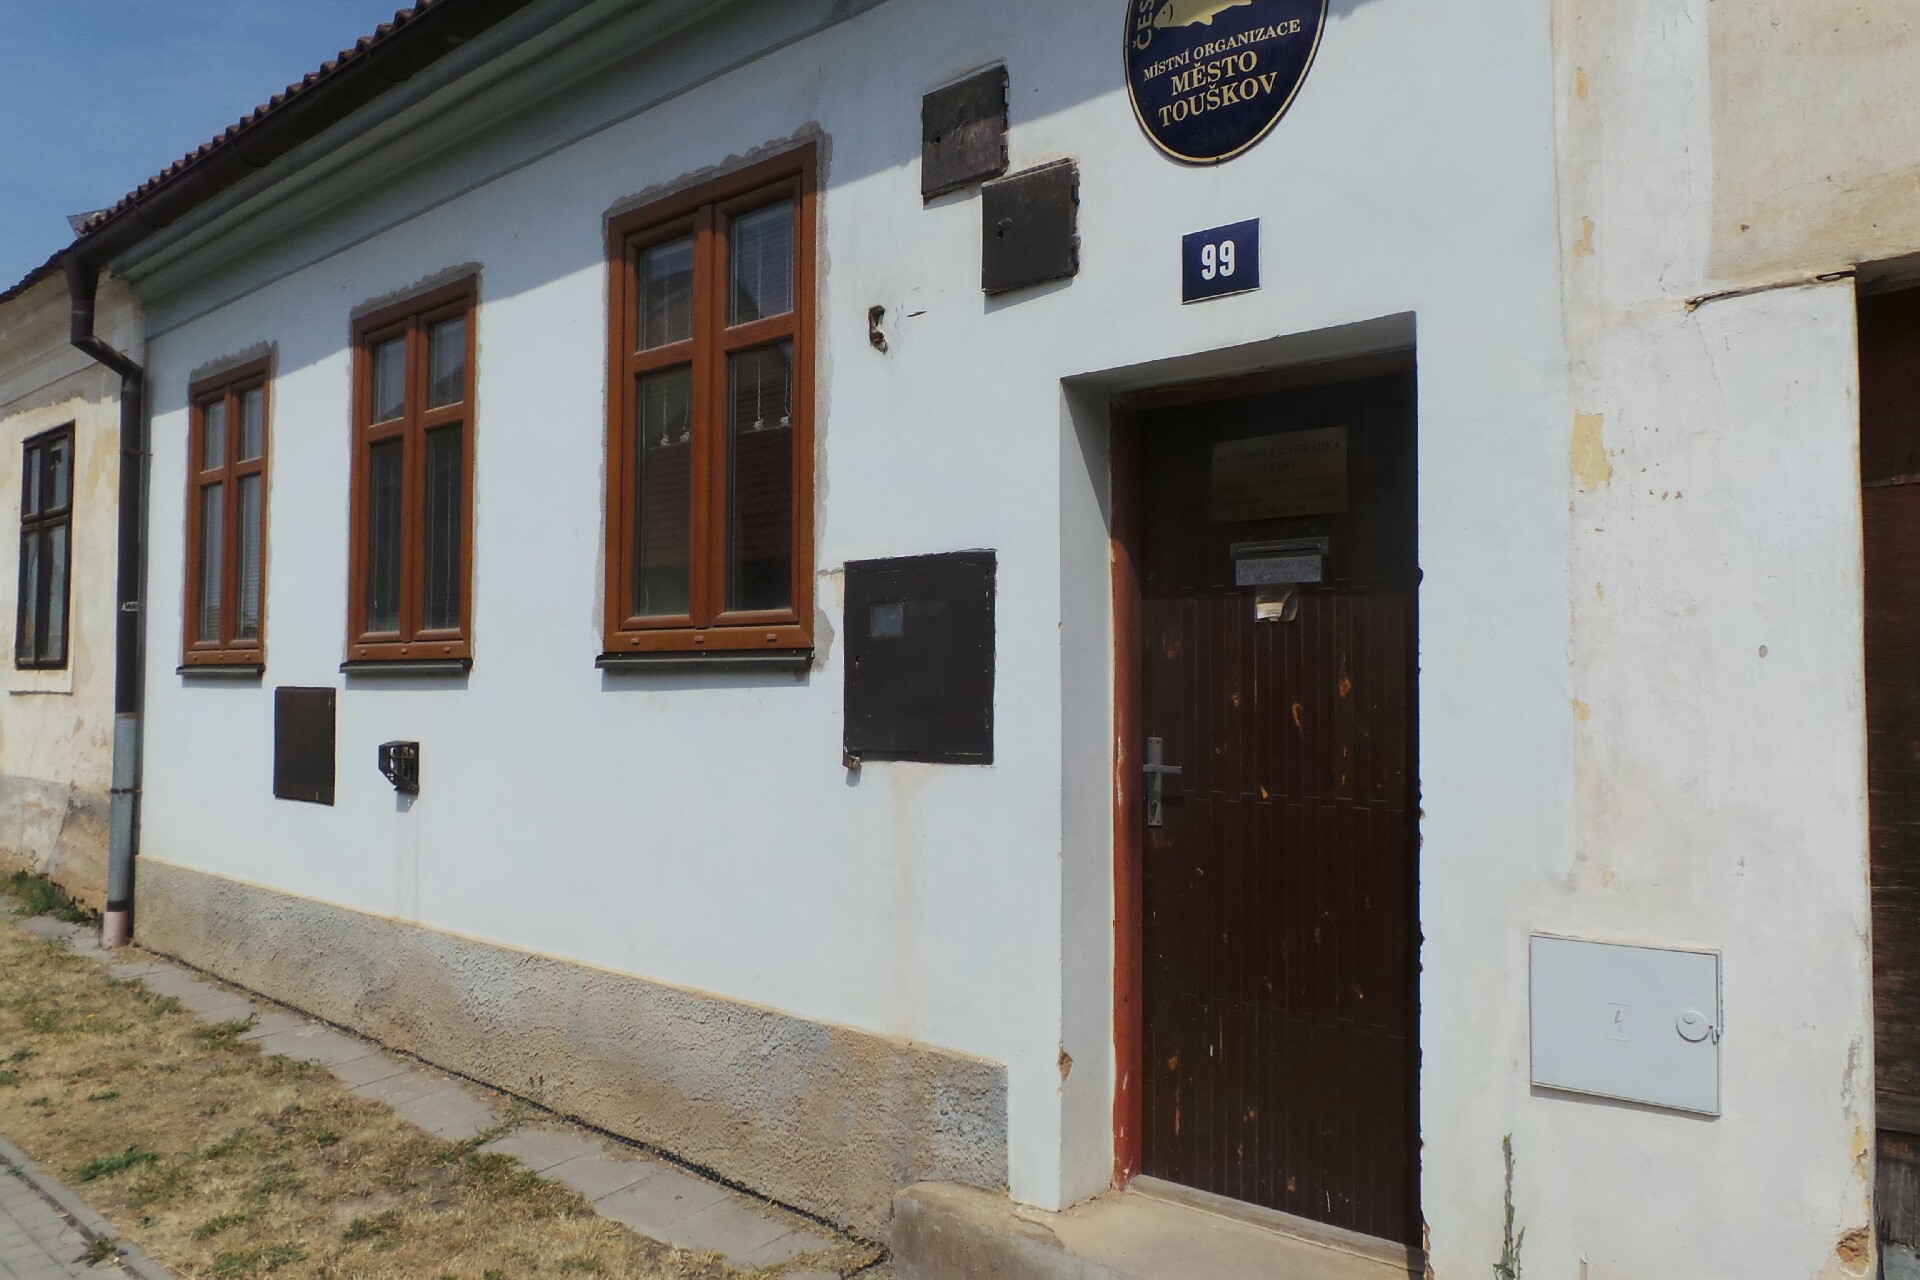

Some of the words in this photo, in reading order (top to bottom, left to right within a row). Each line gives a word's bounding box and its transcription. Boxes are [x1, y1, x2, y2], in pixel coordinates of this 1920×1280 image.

[1143, 48, 1190, 82] MÍSTNÍ
[1193, 19, 1301, 59] ORGANIZACE
[1170, 50, 1259, 96] MĚSTO
[1158, 71, 1279, 127] TOUŠKOV
[1201, 240, 1235, 280] 99
